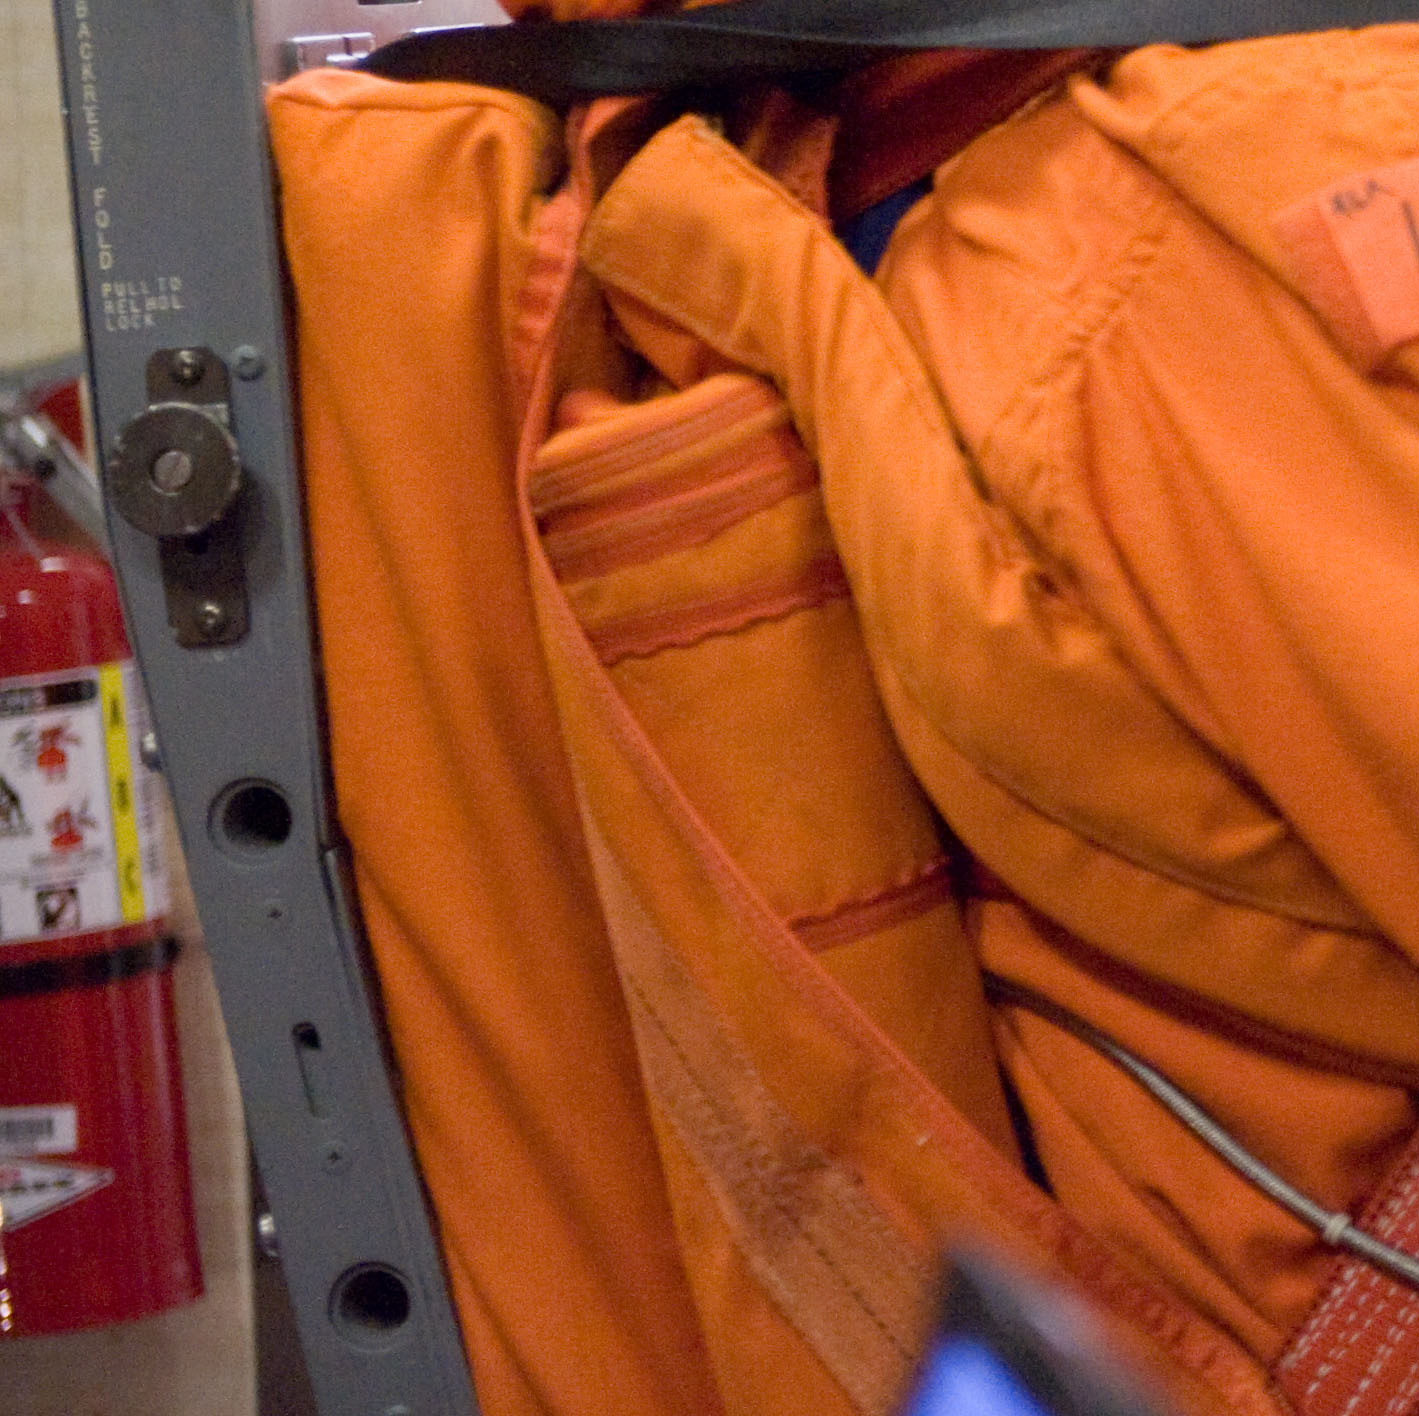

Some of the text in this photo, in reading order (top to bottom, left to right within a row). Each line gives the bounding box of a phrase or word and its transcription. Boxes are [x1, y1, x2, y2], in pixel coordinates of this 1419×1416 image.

[76, 0, 115, 270] BACKREST FOLD
[101, 277, 183, 297] PULL TO
[103, 298, 142, 315] REL
[105, 314, 156, 332] LOCK
